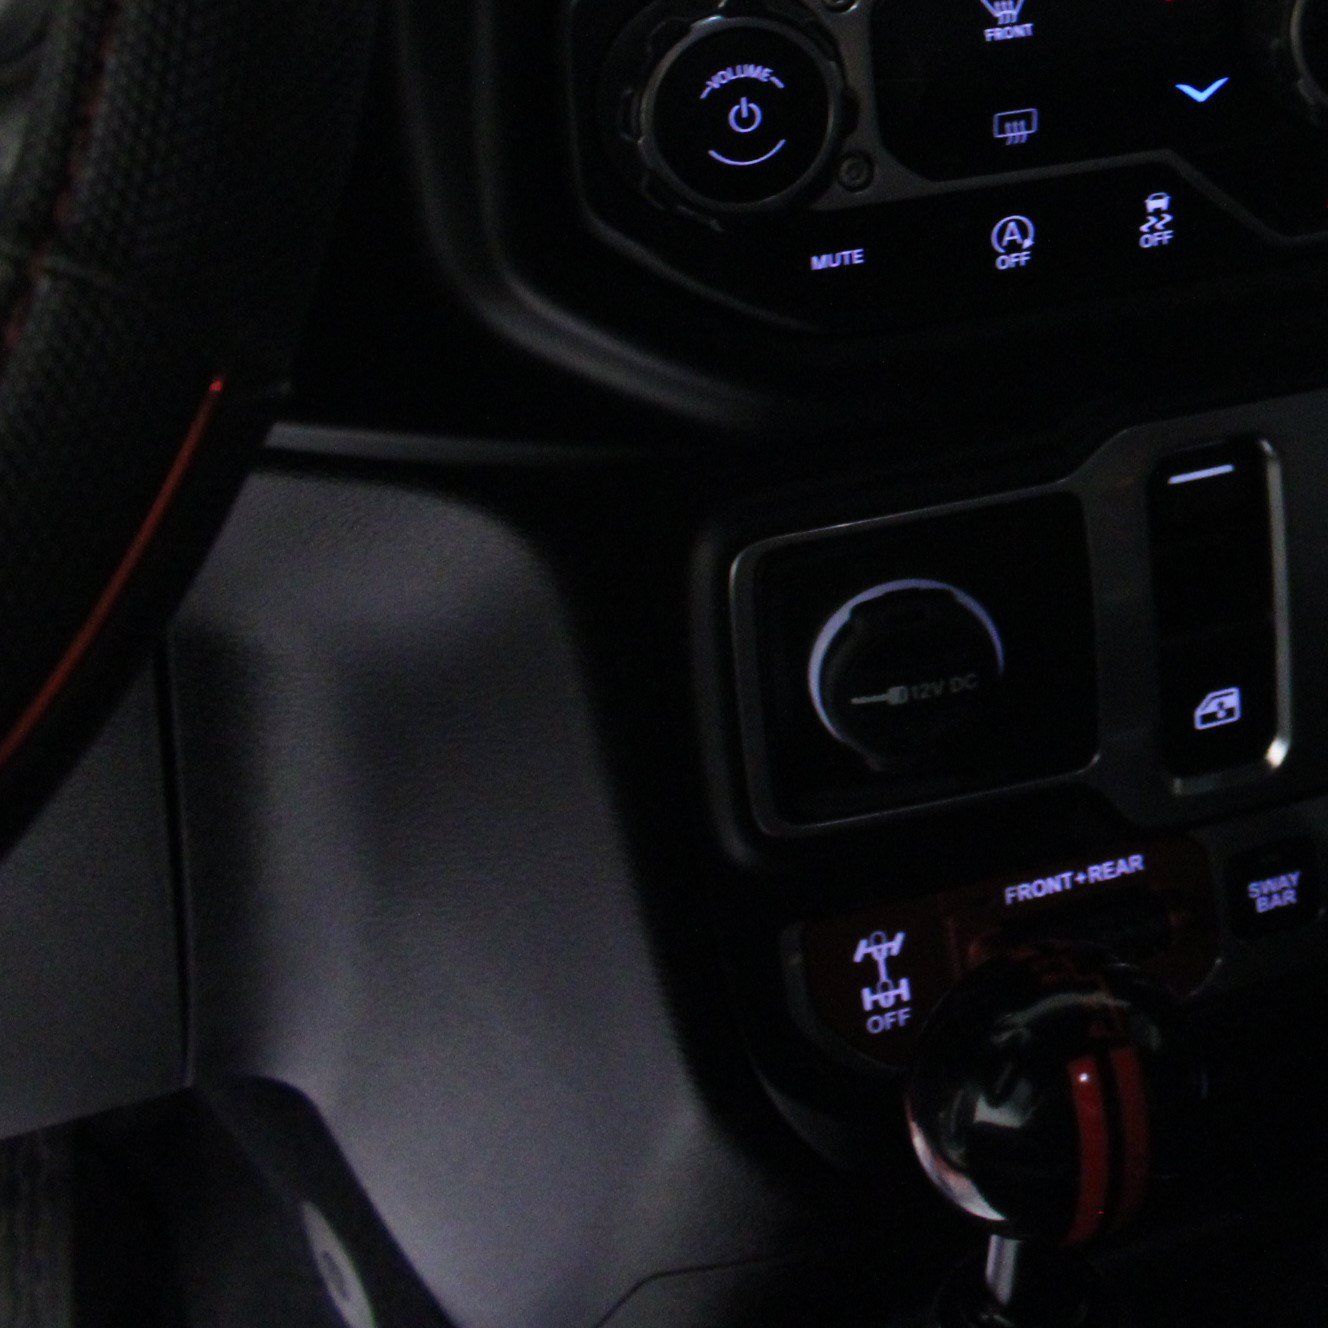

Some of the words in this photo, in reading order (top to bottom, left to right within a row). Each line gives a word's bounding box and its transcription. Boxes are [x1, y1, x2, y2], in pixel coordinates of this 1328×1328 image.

[983, 21, 1036, 42] FRONT
[705, 63, 774, 89] VOLUME
[1139, 229, 1176, 250] OFF
[809, 247, 866, 272] MUTE
[994, 249, 1033, 271] OFF
[1005, 853, 1146, 906] FRONT+REAR
[1247, 869, 1302, 899] SWAY
[1255, 887, 1298, 914] BAR
[865, 1005, 912, 1036] OFF
